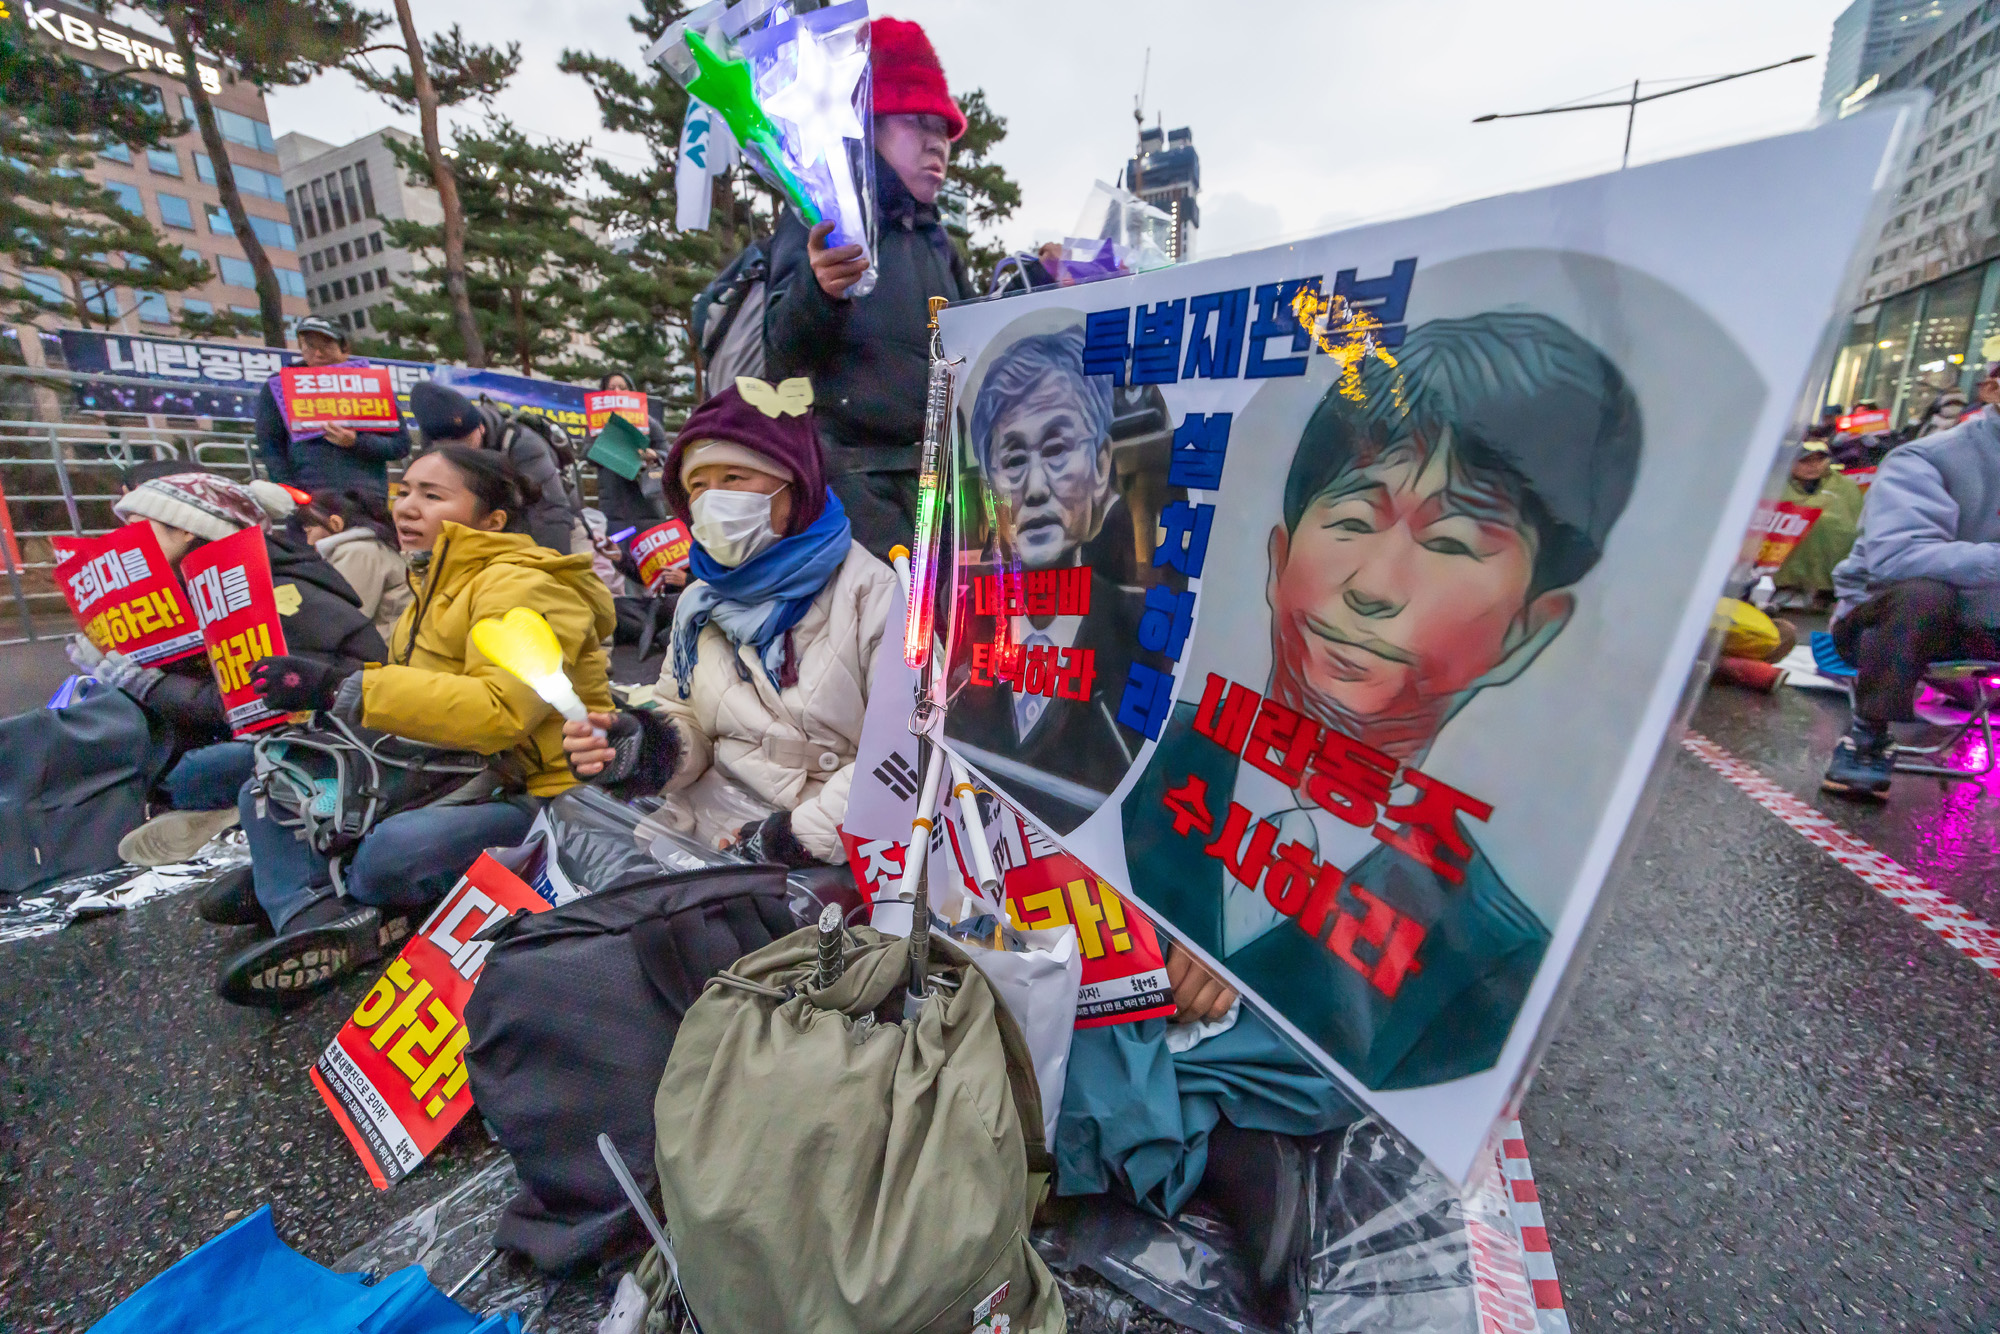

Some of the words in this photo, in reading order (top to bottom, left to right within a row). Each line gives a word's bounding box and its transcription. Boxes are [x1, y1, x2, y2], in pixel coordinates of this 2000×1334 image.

[105, 338, 282, 382] 내란공범
[1083, 257, 1418, 387] 특별재판부
[68, 547, 152, 613] 조희대를
[1117, 411, 1234, 742] 설치하라
[1192, 672, 1495, 885] 내란동조
[1163, 773, 1428, 998] 수사하라
[328, 1044, 370, 1097] 촛불대행진으로
[365, 1092, 388, 1122] 모이자!
[353, 957, 470, 1119] 하라!
